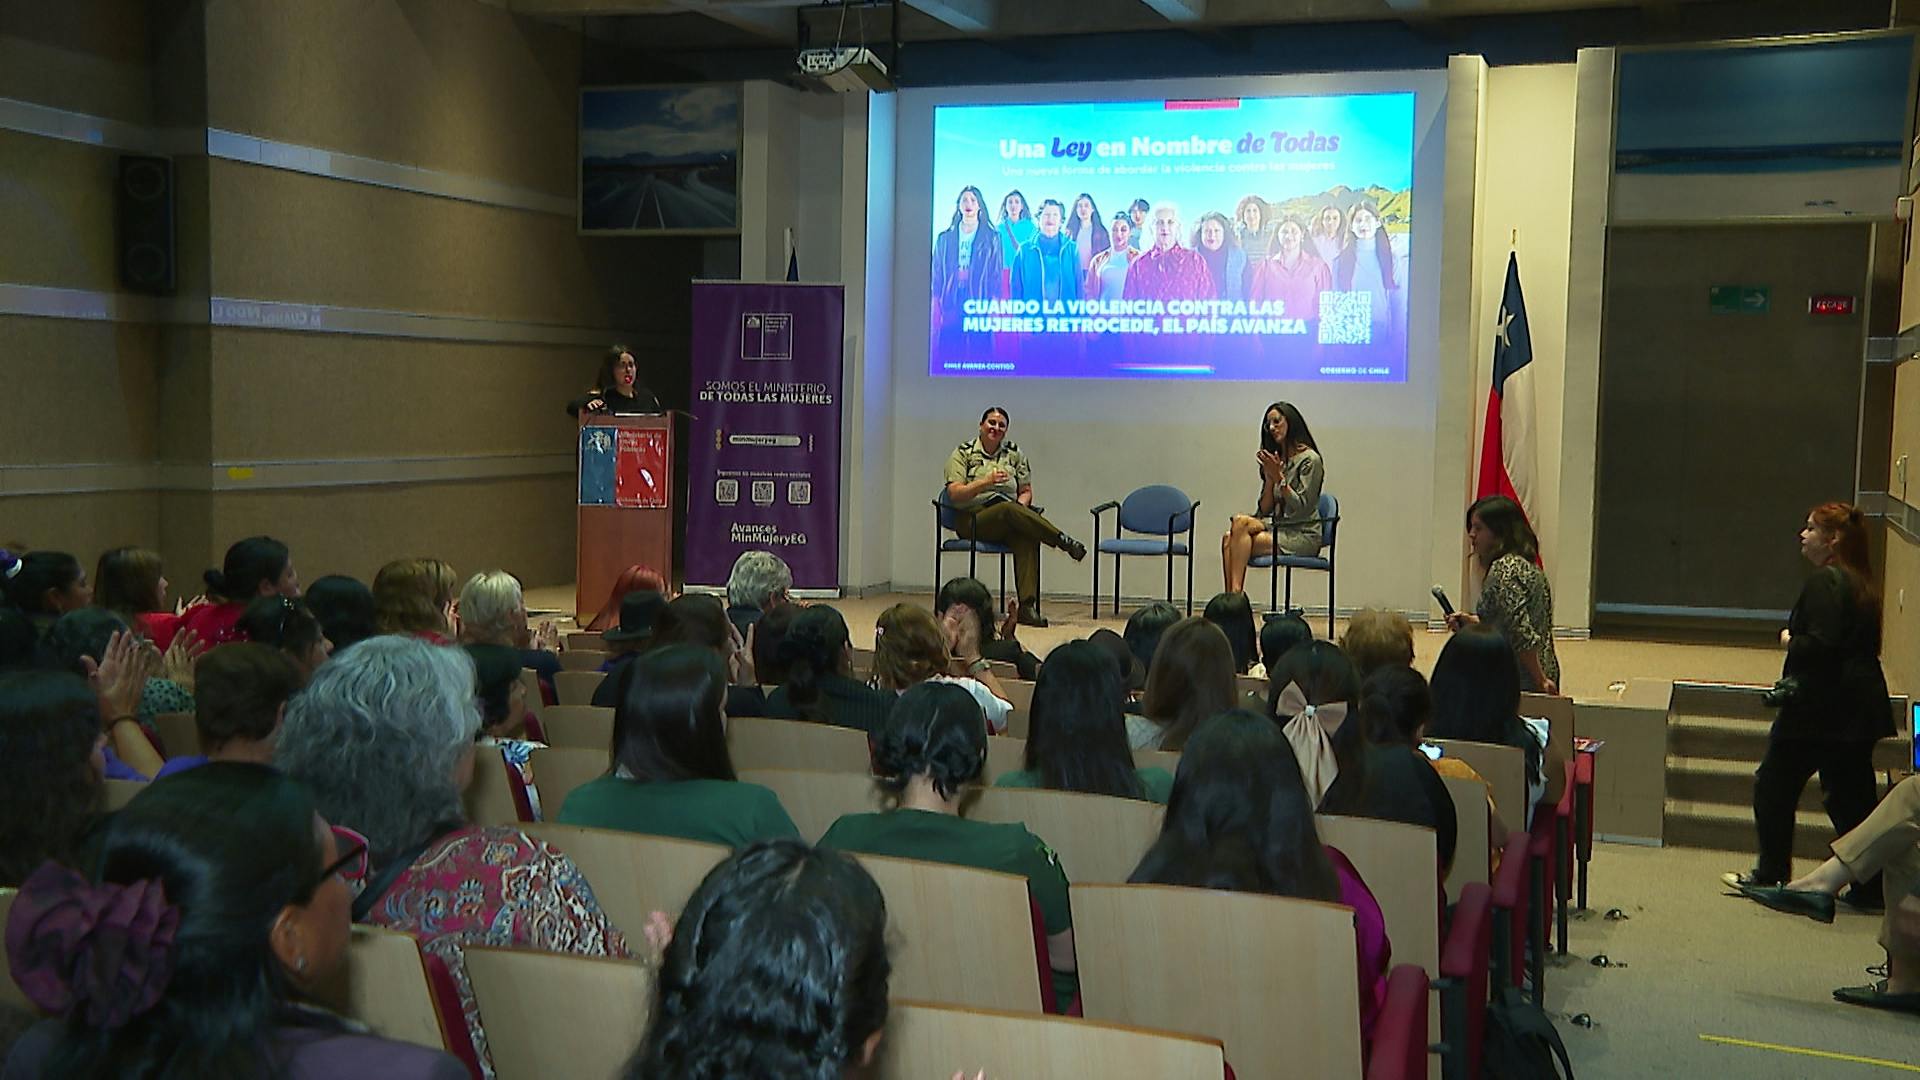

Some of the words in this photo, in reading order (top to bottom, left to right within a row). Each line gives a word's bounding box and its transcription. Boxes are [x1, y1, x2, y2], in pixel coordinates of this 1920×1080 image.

[999, 138, 1046, 160] Una
[1051, 137, 1093, 162] Ley
[1096, 140, 1127, 157] en
[1131, 134, 1233, 157] Nombre
[1236, 132, 1266, 154] de
[1270, 130, 1340, 153] Todas
[1161, 163, 1171, 174] la
[963, 299, 1040, 315] CUANDO
[1042, 299, 1065, 315] LA
[1066, 299, 1165, 315] VIOLENCIA
[1167, 299, 1247, 315] CONTRA
[1250, 300, 1285, 315] LAS
[963, 317, 1044, 333] MUJERES
[1046, 317, 1160, 336] RETROCEDE,
[1162, 318, 1184, 333] EL
[1186, 315, 1228, 334] PAÍS
[1230, 318, 1308, 334] AVANZA
[986, 362, 1016, 371] CONTIGO
[1319, 366, 1357, 375] GOBIERNO
[1357, 367, 1367, 375] DE
[1368, 367, 1390, 375] CHILE
[705, 381, 746, 392] SOMOS
[748, 381, 760, 393] EL
[763, 382, 826, 395] MINISTERIO
[699, 390, 714, 401] DE
[717, 391, 755, 402] TODAS
[757, 392, 778, 403] LAS
[780, 393, 833, 405] MUJERES
[731, 522, 777, 534] Avances
[731, 532, 807, 546] MinMujeryEG
